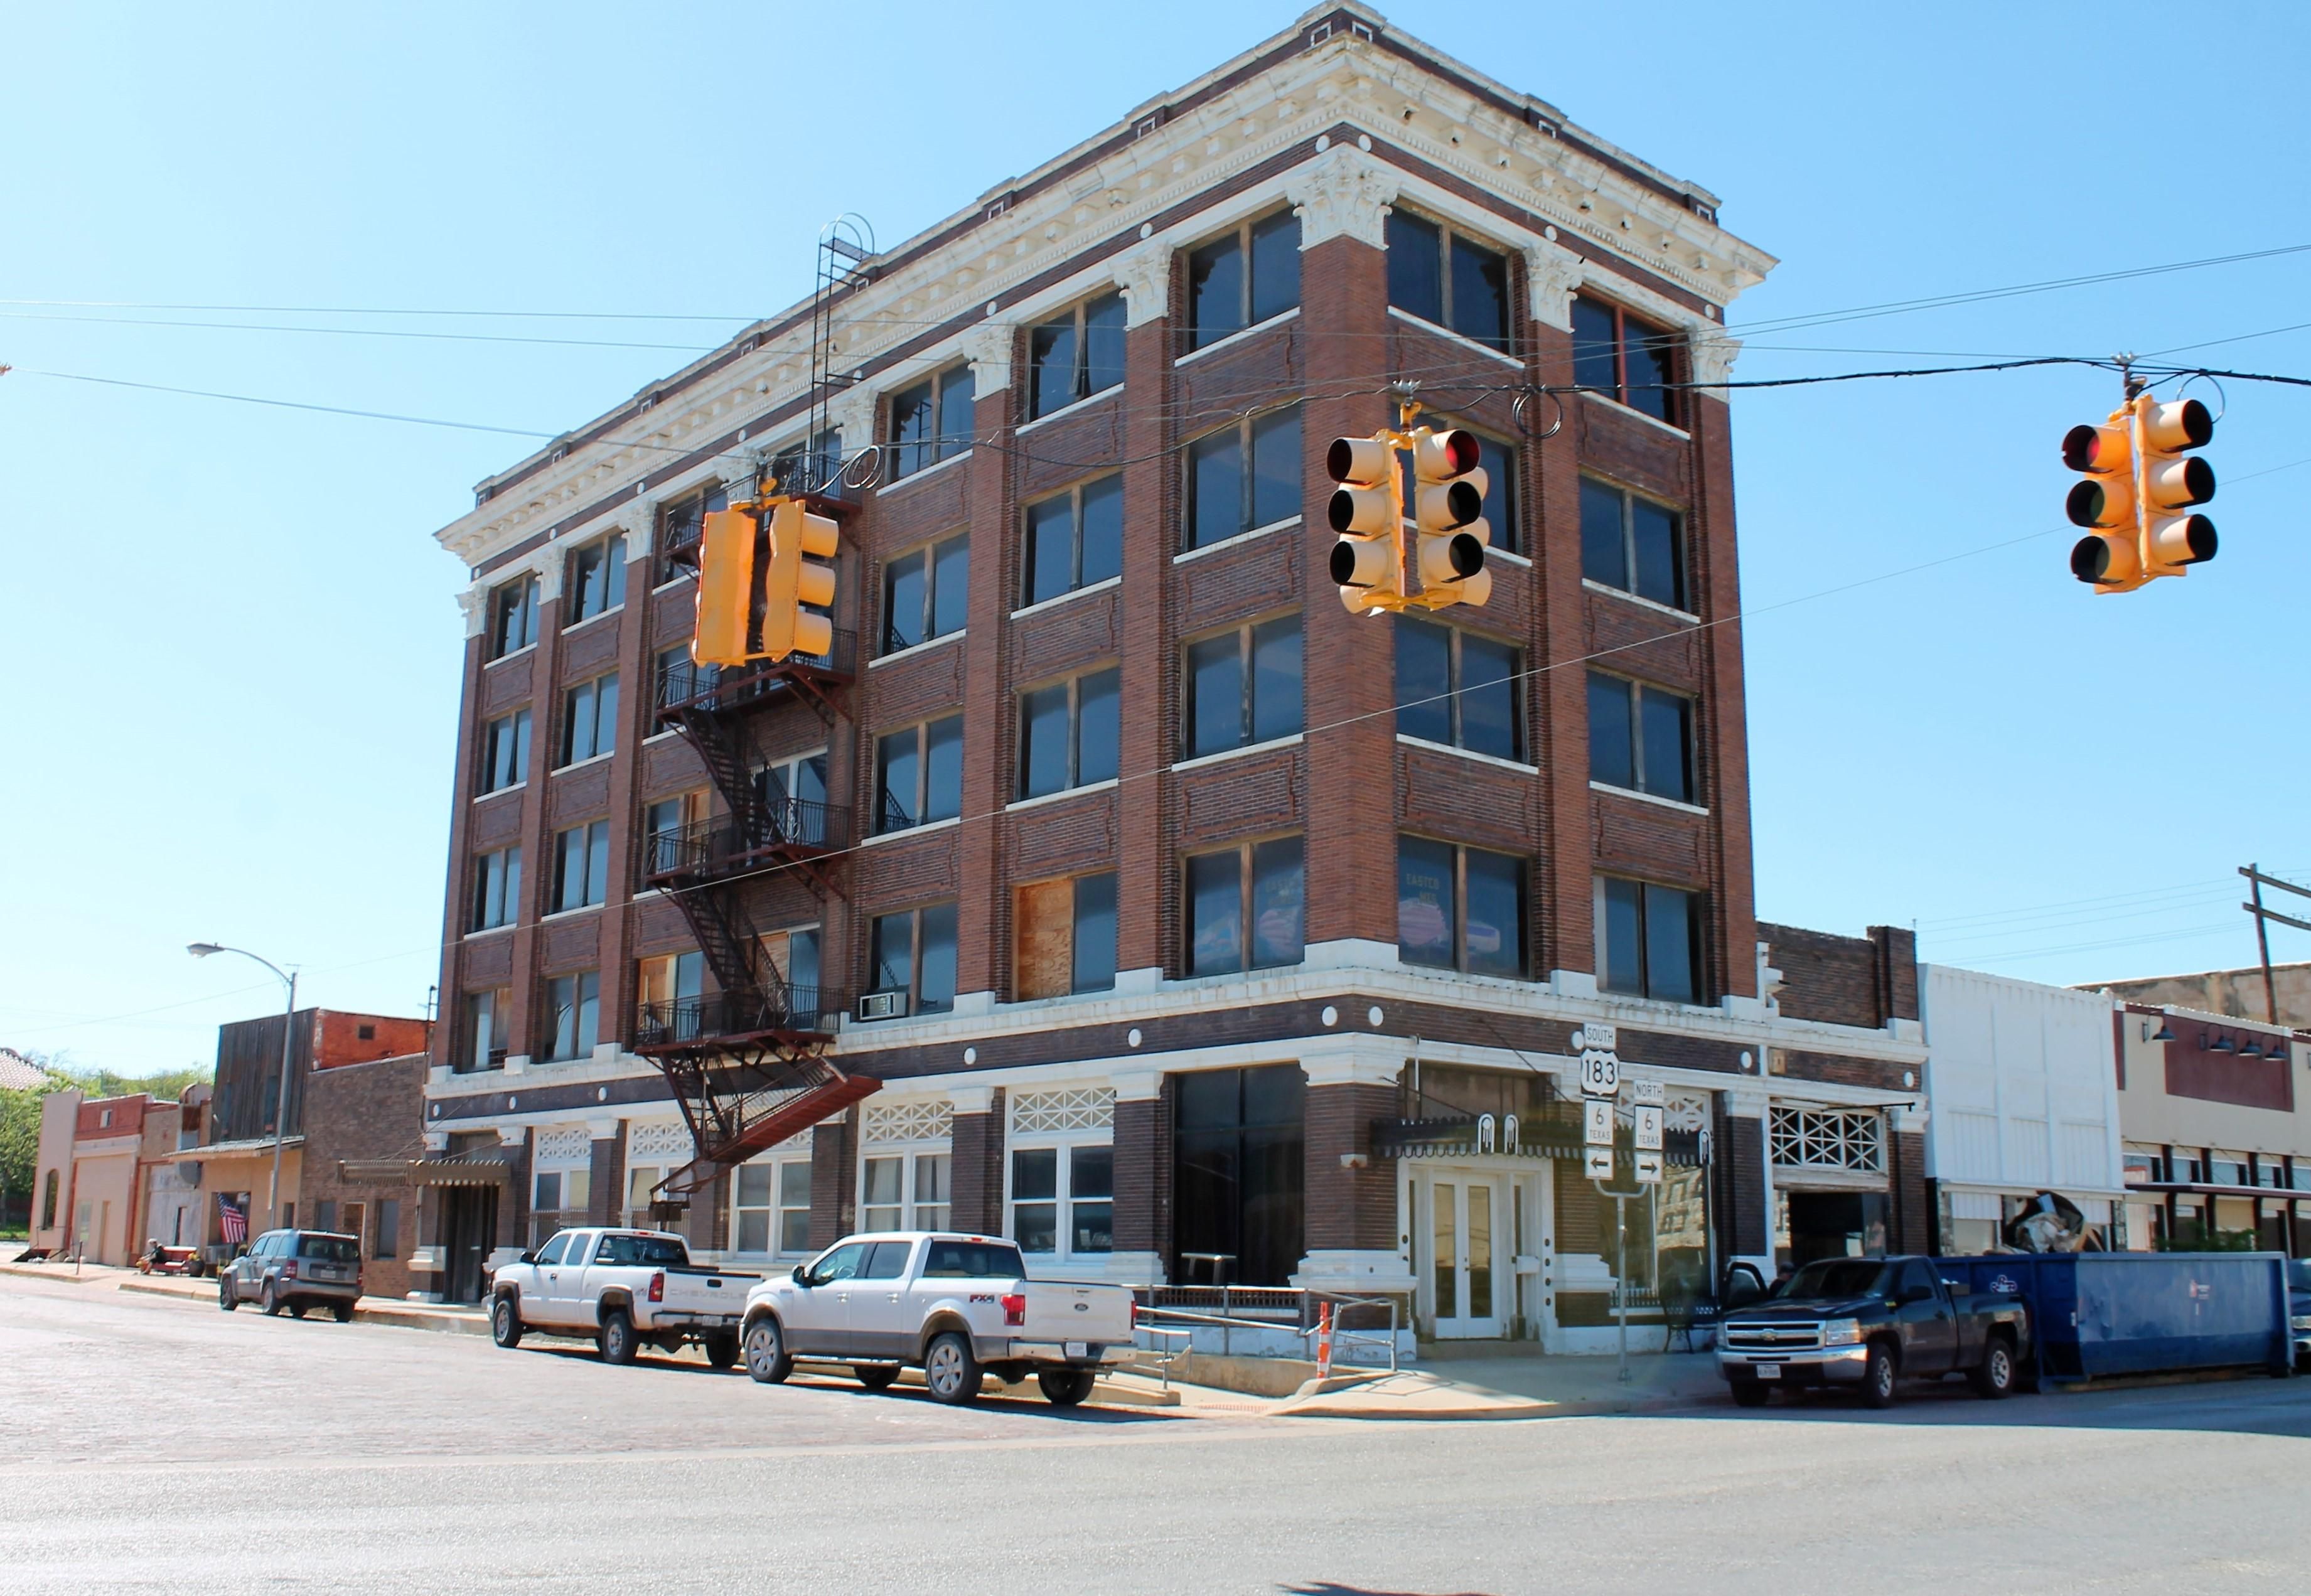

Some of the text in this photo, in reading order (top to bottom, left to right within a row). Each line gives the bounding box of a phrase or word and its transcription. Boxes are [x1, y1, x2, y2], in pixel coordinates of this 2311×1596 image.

[1587, 1028, 1613, 1042] SOUTH
[1586, 1059, 1614, 1085] 183
[1636, 1084, 1663, 1098] NORTH
[1596, 1108, 1604, 1125] 6
[1645, 1113, 1653, 1130] 6
[1589, 1129, 1611, 1140] TEXAS
[1638, 1134, 1660, 1145] TEXAS
[970, 1294, 995, 1304] FX4
